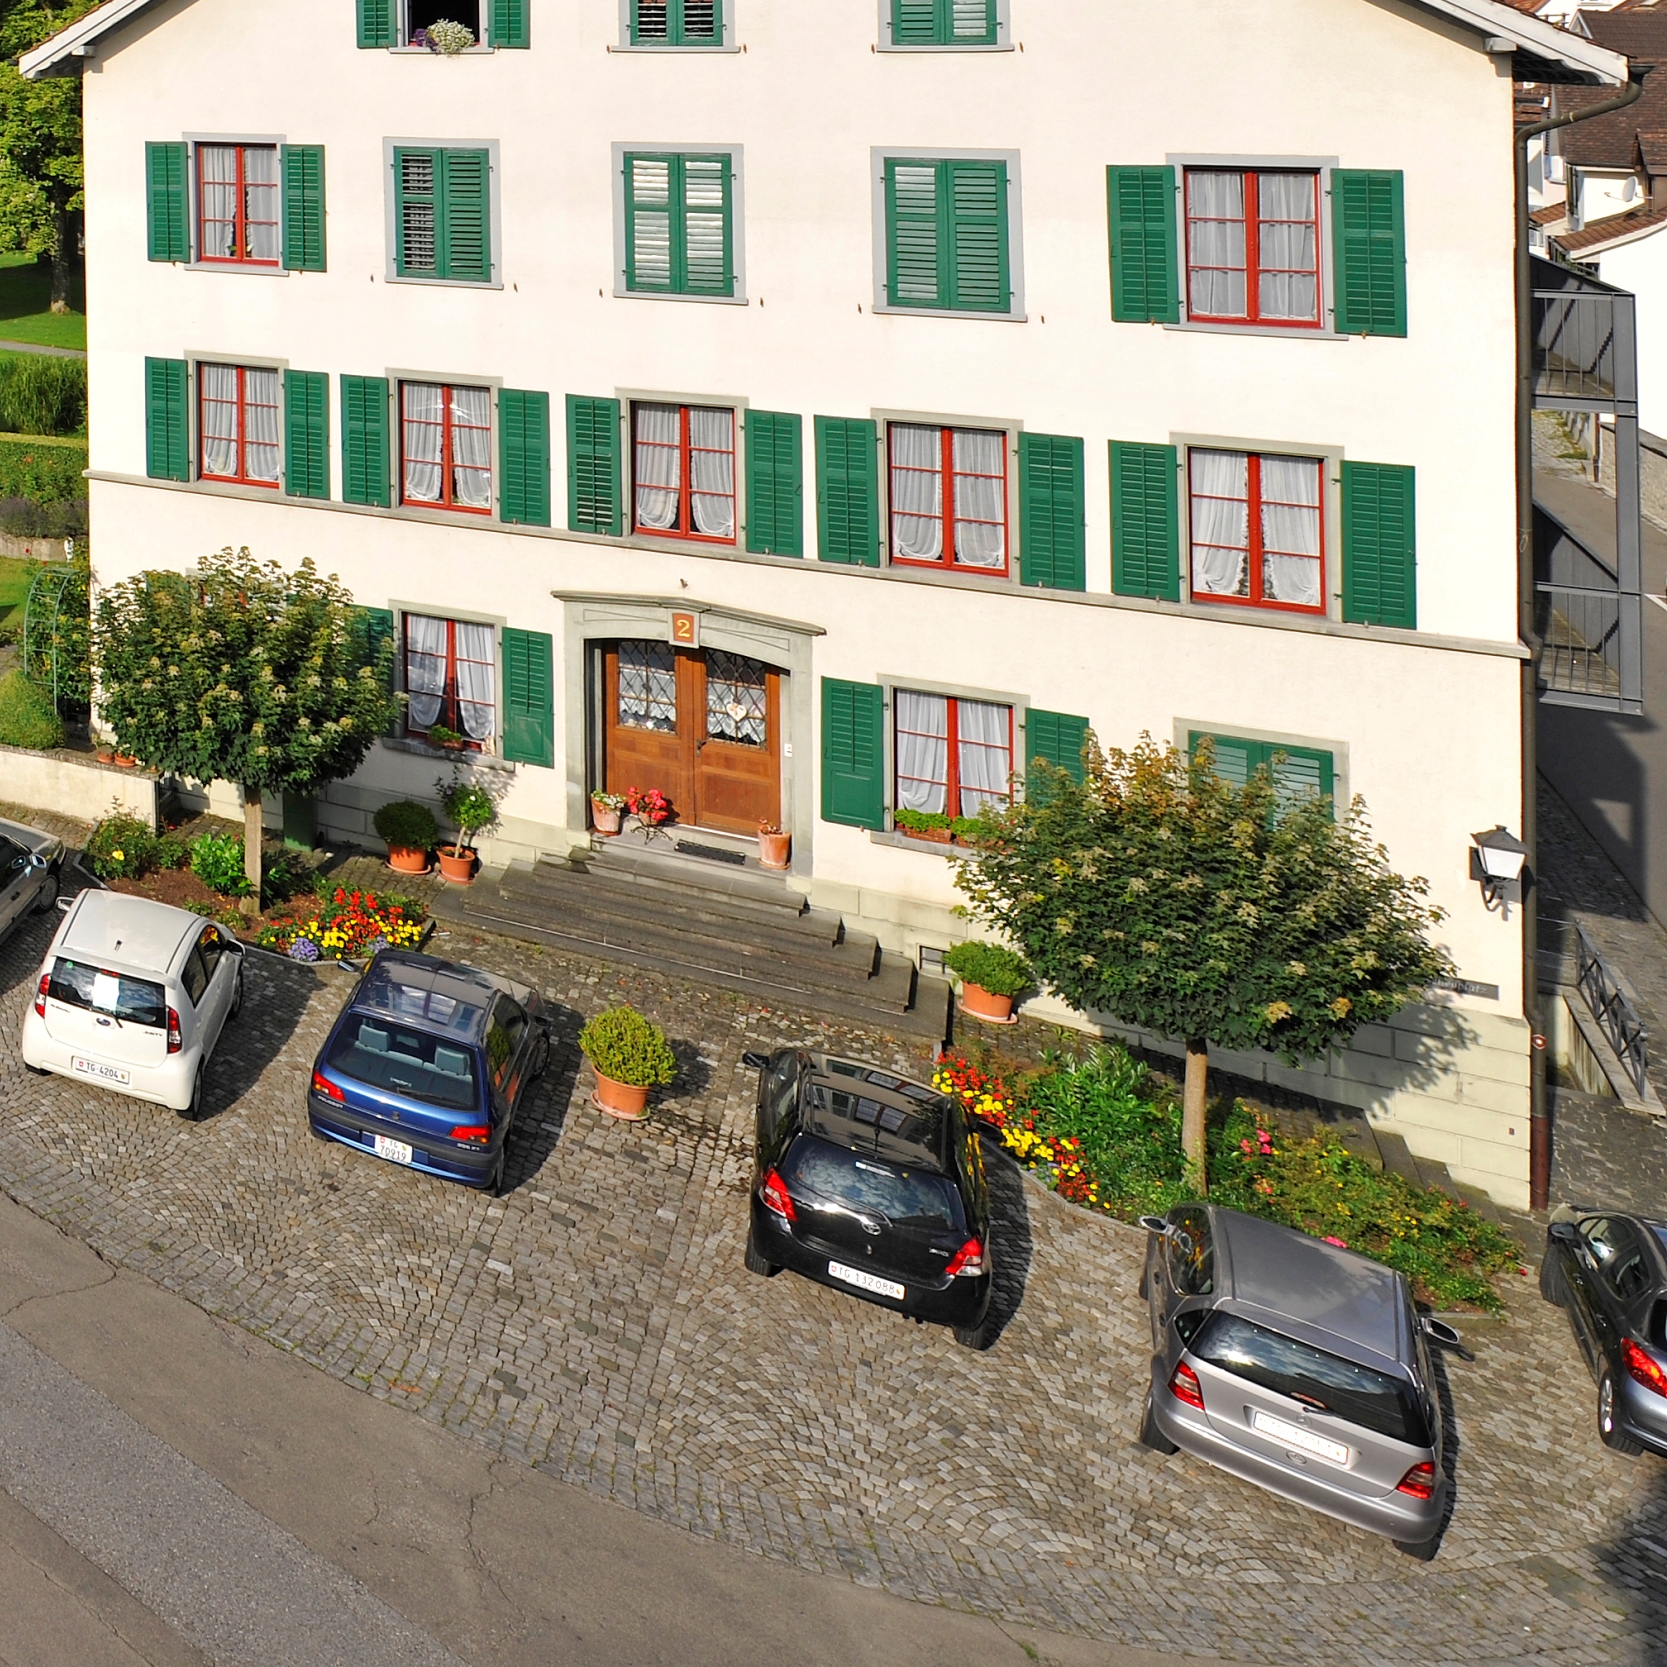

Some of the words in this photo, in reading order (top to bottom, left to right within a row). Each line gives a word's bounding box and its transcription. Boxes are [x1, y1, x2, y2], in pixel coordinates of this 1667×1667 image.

[677, 619, 691, 638] 2
[86, 1062, 96, 1072] TG
[99, 1065, 119, 1079] 4204
[389, 1139, 398, 1149] TG
[380, 1145, 407, 1162] 70919
[838, 1266, 851, 1279] TG
[855, 1272, 895, 1295] 132088
